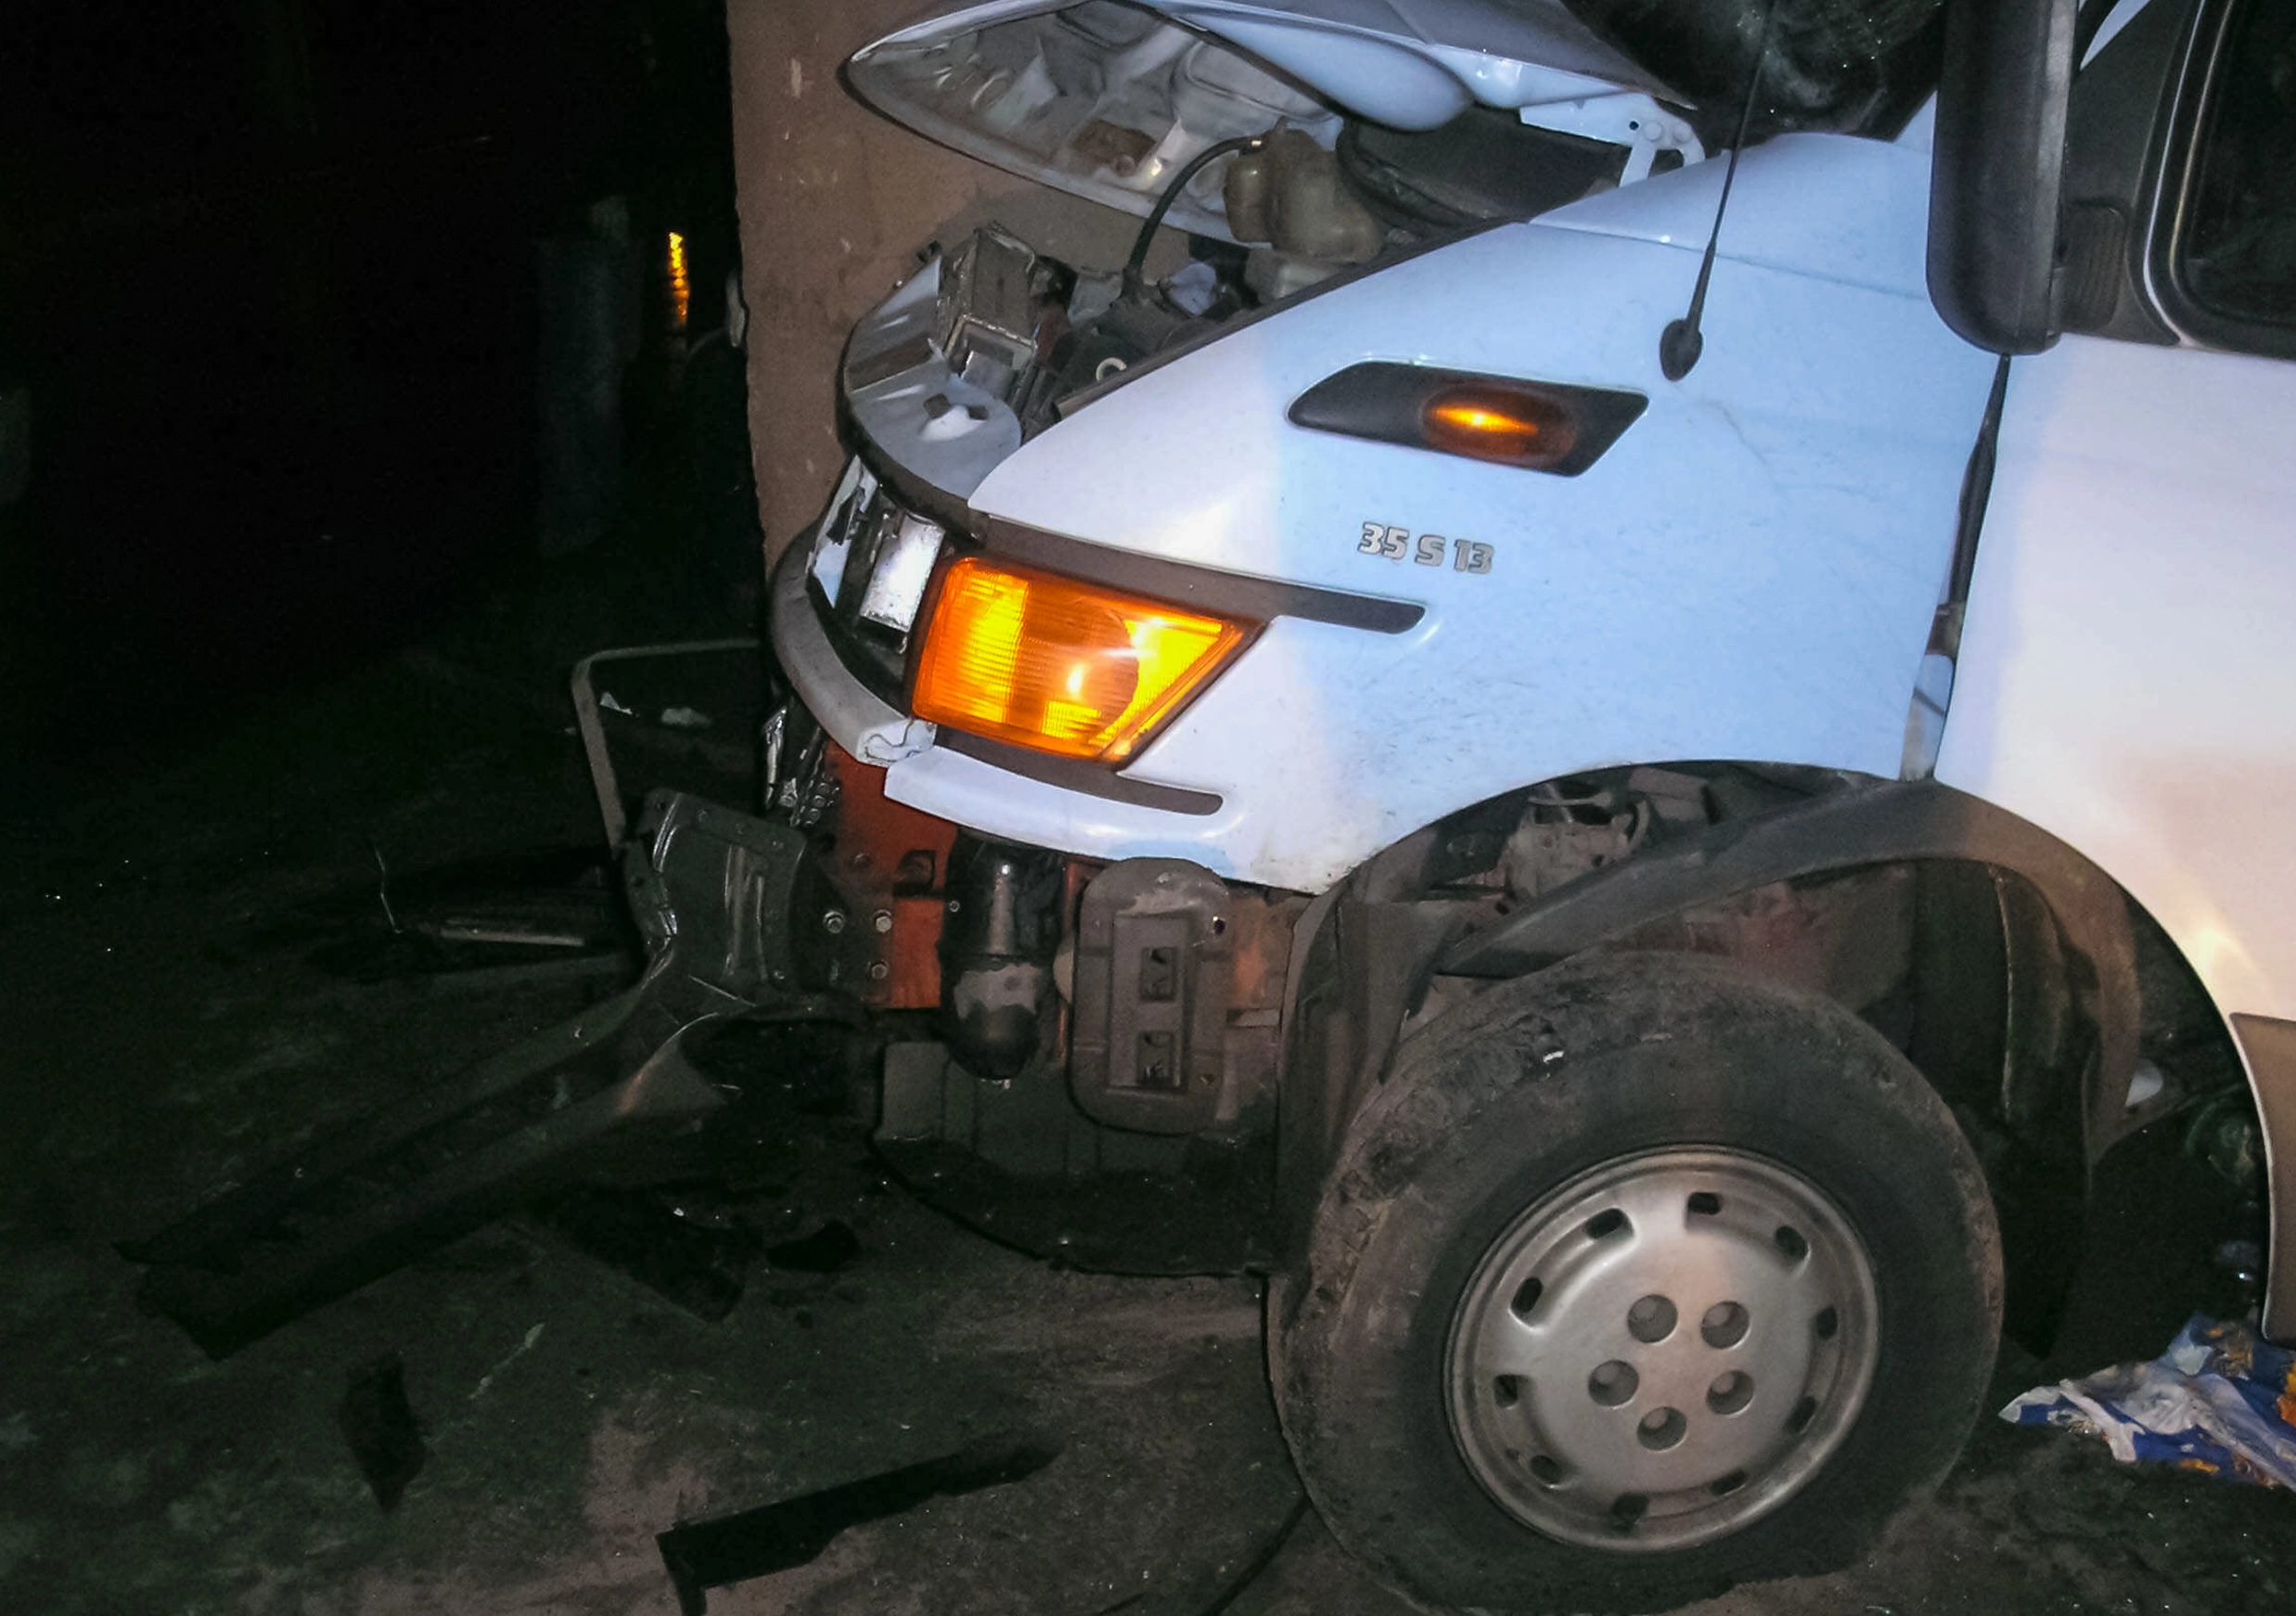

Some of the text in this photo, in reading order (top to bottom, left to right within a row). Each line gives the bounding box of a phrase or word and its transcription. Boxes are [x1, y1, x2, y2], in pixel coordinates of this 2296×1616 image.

[1357, 521, 1494, 573] 35 S 13
